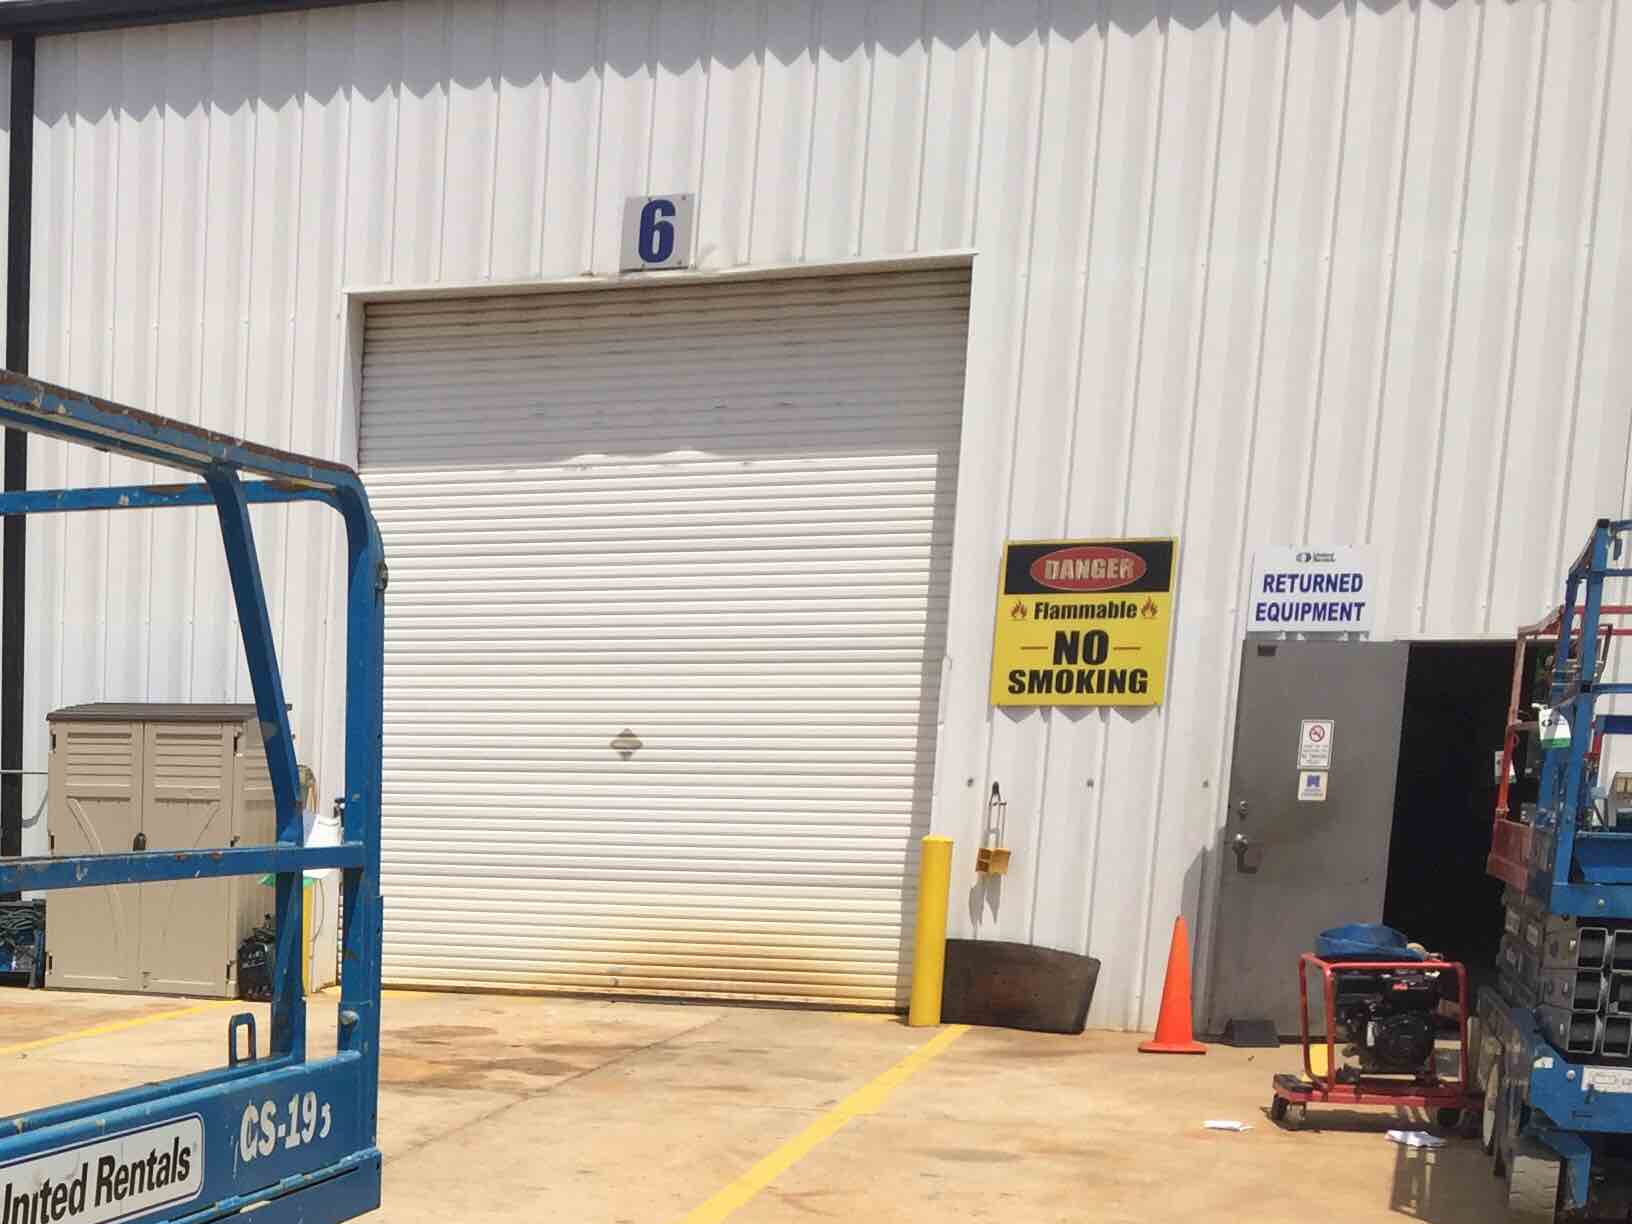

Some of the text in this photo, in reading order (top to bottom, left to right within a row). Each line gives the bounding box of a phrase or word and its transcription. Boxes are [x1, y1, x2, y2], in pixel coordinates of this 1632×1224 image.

[638, 199, 675, 263] 6
[1044, 558, 1135, 580] DANGER
[1262, 572, 1364, 593] RETURNED
[1034, 600, 1138, 621] Flammable
[1255, 601, 1366, 623] EQUIPMENT
[1052, 629, 1110, 666] NO
[1007, 668, 1149, 695] SMOKING
[95, 1135, 192, 1207] Rentals
